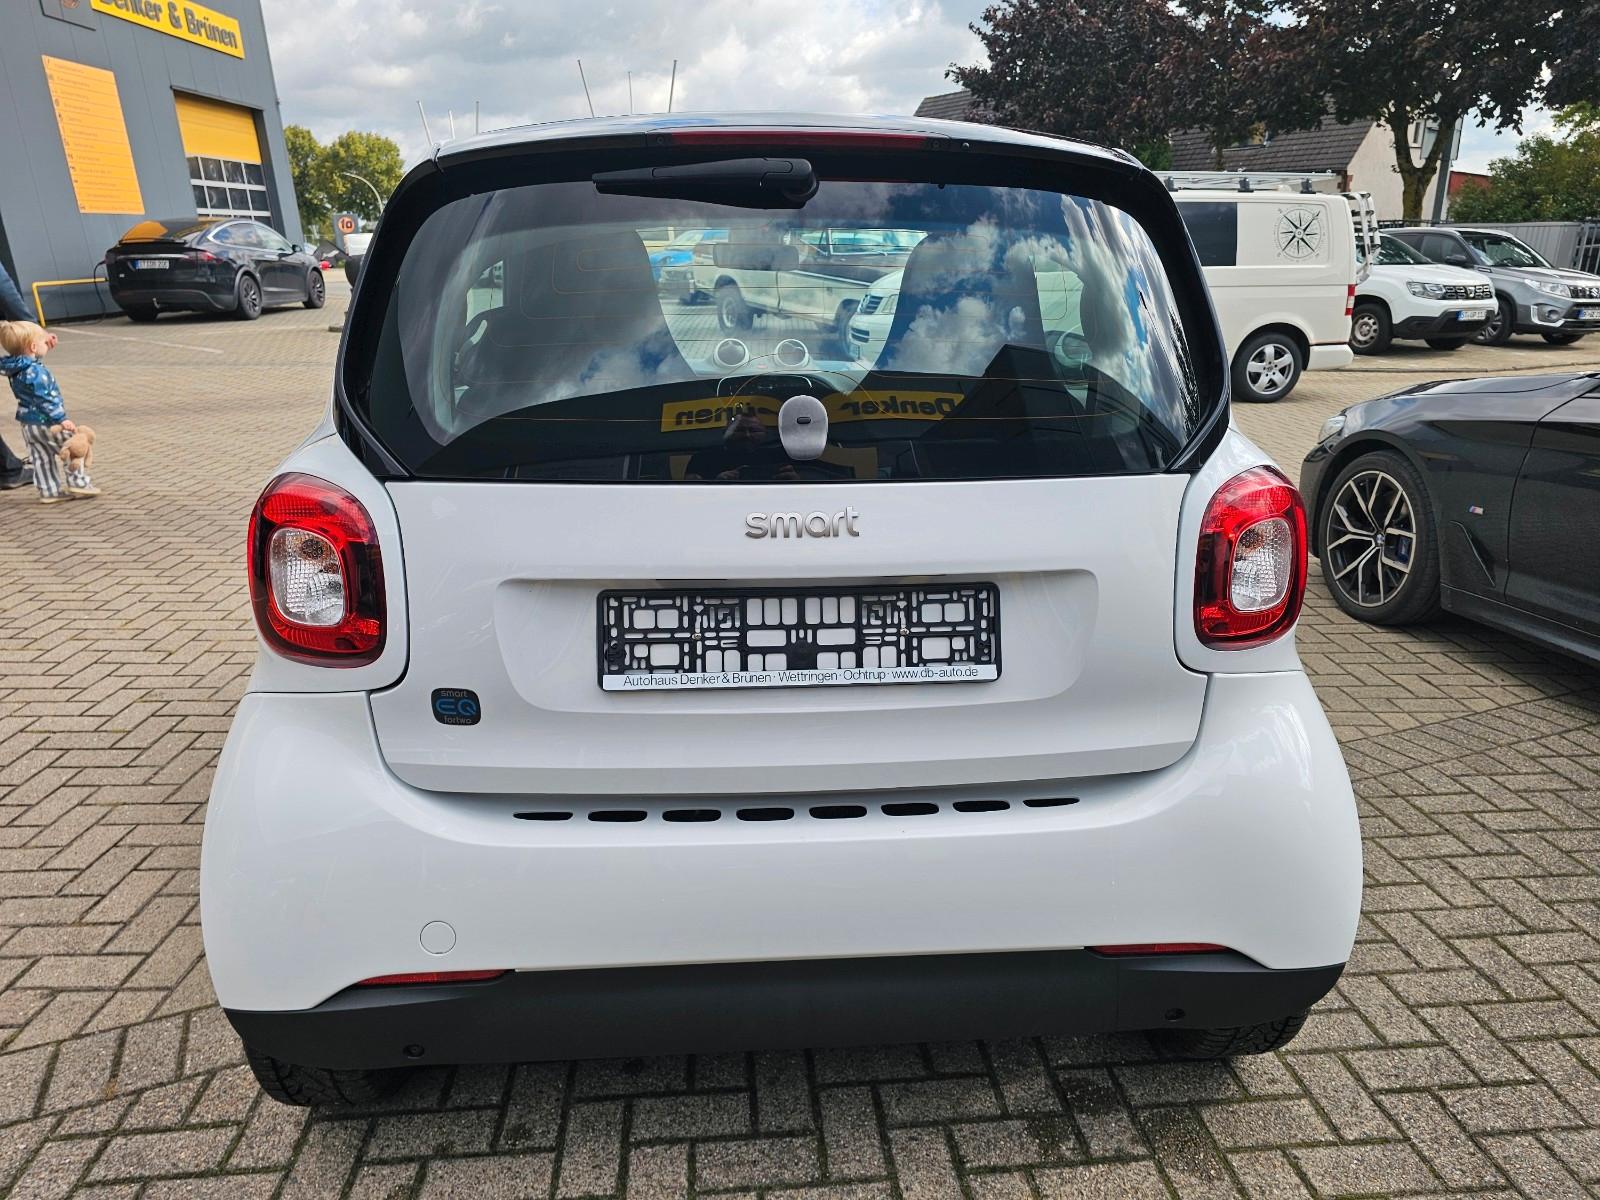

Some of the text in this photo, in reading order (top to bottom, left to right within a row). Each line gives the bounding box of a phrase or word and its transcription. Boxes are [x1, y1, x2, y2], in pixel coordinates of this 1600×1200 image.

[99, 0, 238, 49] enker & Brünen
[744, 505, 860, 539] smart
[623, 667, 978, 687] Autohaus Denker & Brünen Wettringen Ochtrup www.db-auto.de
[436, 698, 476, 715] EQ
[443, 715, 473, 724] fortwo
